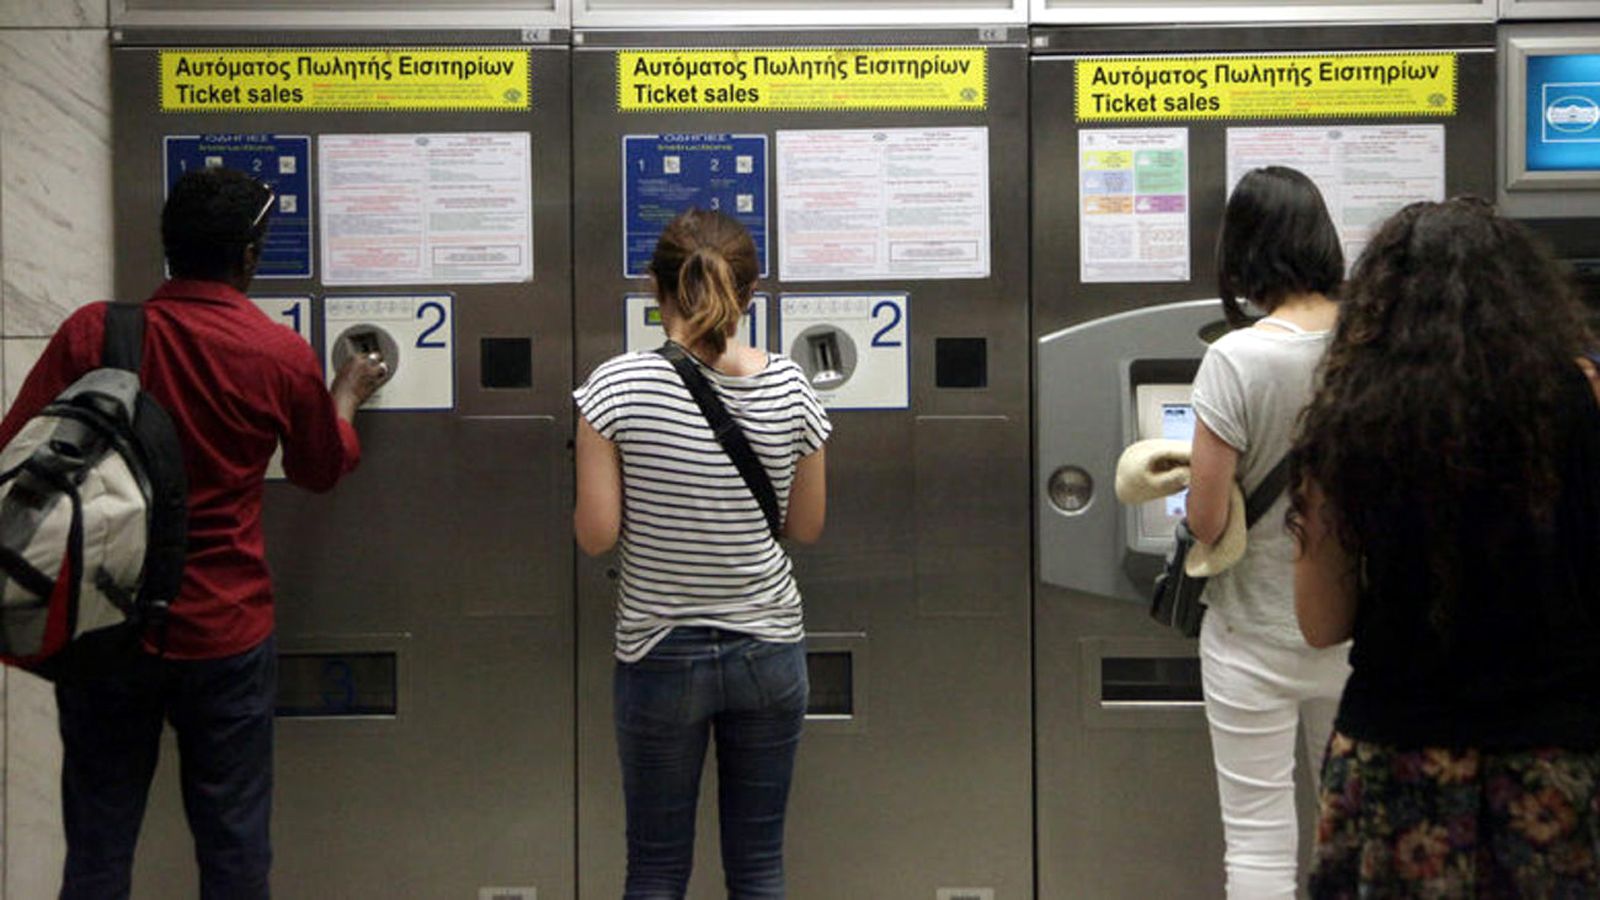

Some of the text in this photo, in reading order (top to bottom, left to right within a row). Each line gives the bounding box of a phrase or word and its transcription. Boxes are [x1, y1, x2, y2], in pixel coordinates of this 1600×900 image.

[175, 55, 515, 81] Αυτόματος Πωλητής Εισιτηρίων
[633, 54, 971, 80] Αυτόματος Πωλητής Εισιτηρίων
[1091, 60, 1440, 89] Αυτόματος Πωλητής Εισιτηρίων
[175, 84, 241, 104] Ticket
[247, 84, 304, 104] sales
[633, 84, 698, 104] Ticket
[704, 84, 760, 104] sales
[1091, 93, 1157, 113] Ticket
[1164, 92, 1221, 112] sales
[252, 159, 263, 172] 2
[638, 159, 645, 172] 1
[710, 158, 720, 172] 2
[711, 197, 720, 210] 3
[281, 302, 301, 333] 1
[416, 301, 446, 348] 2
[743, 302, 757, 348] 1
[871, 301, 901, 347] 2
